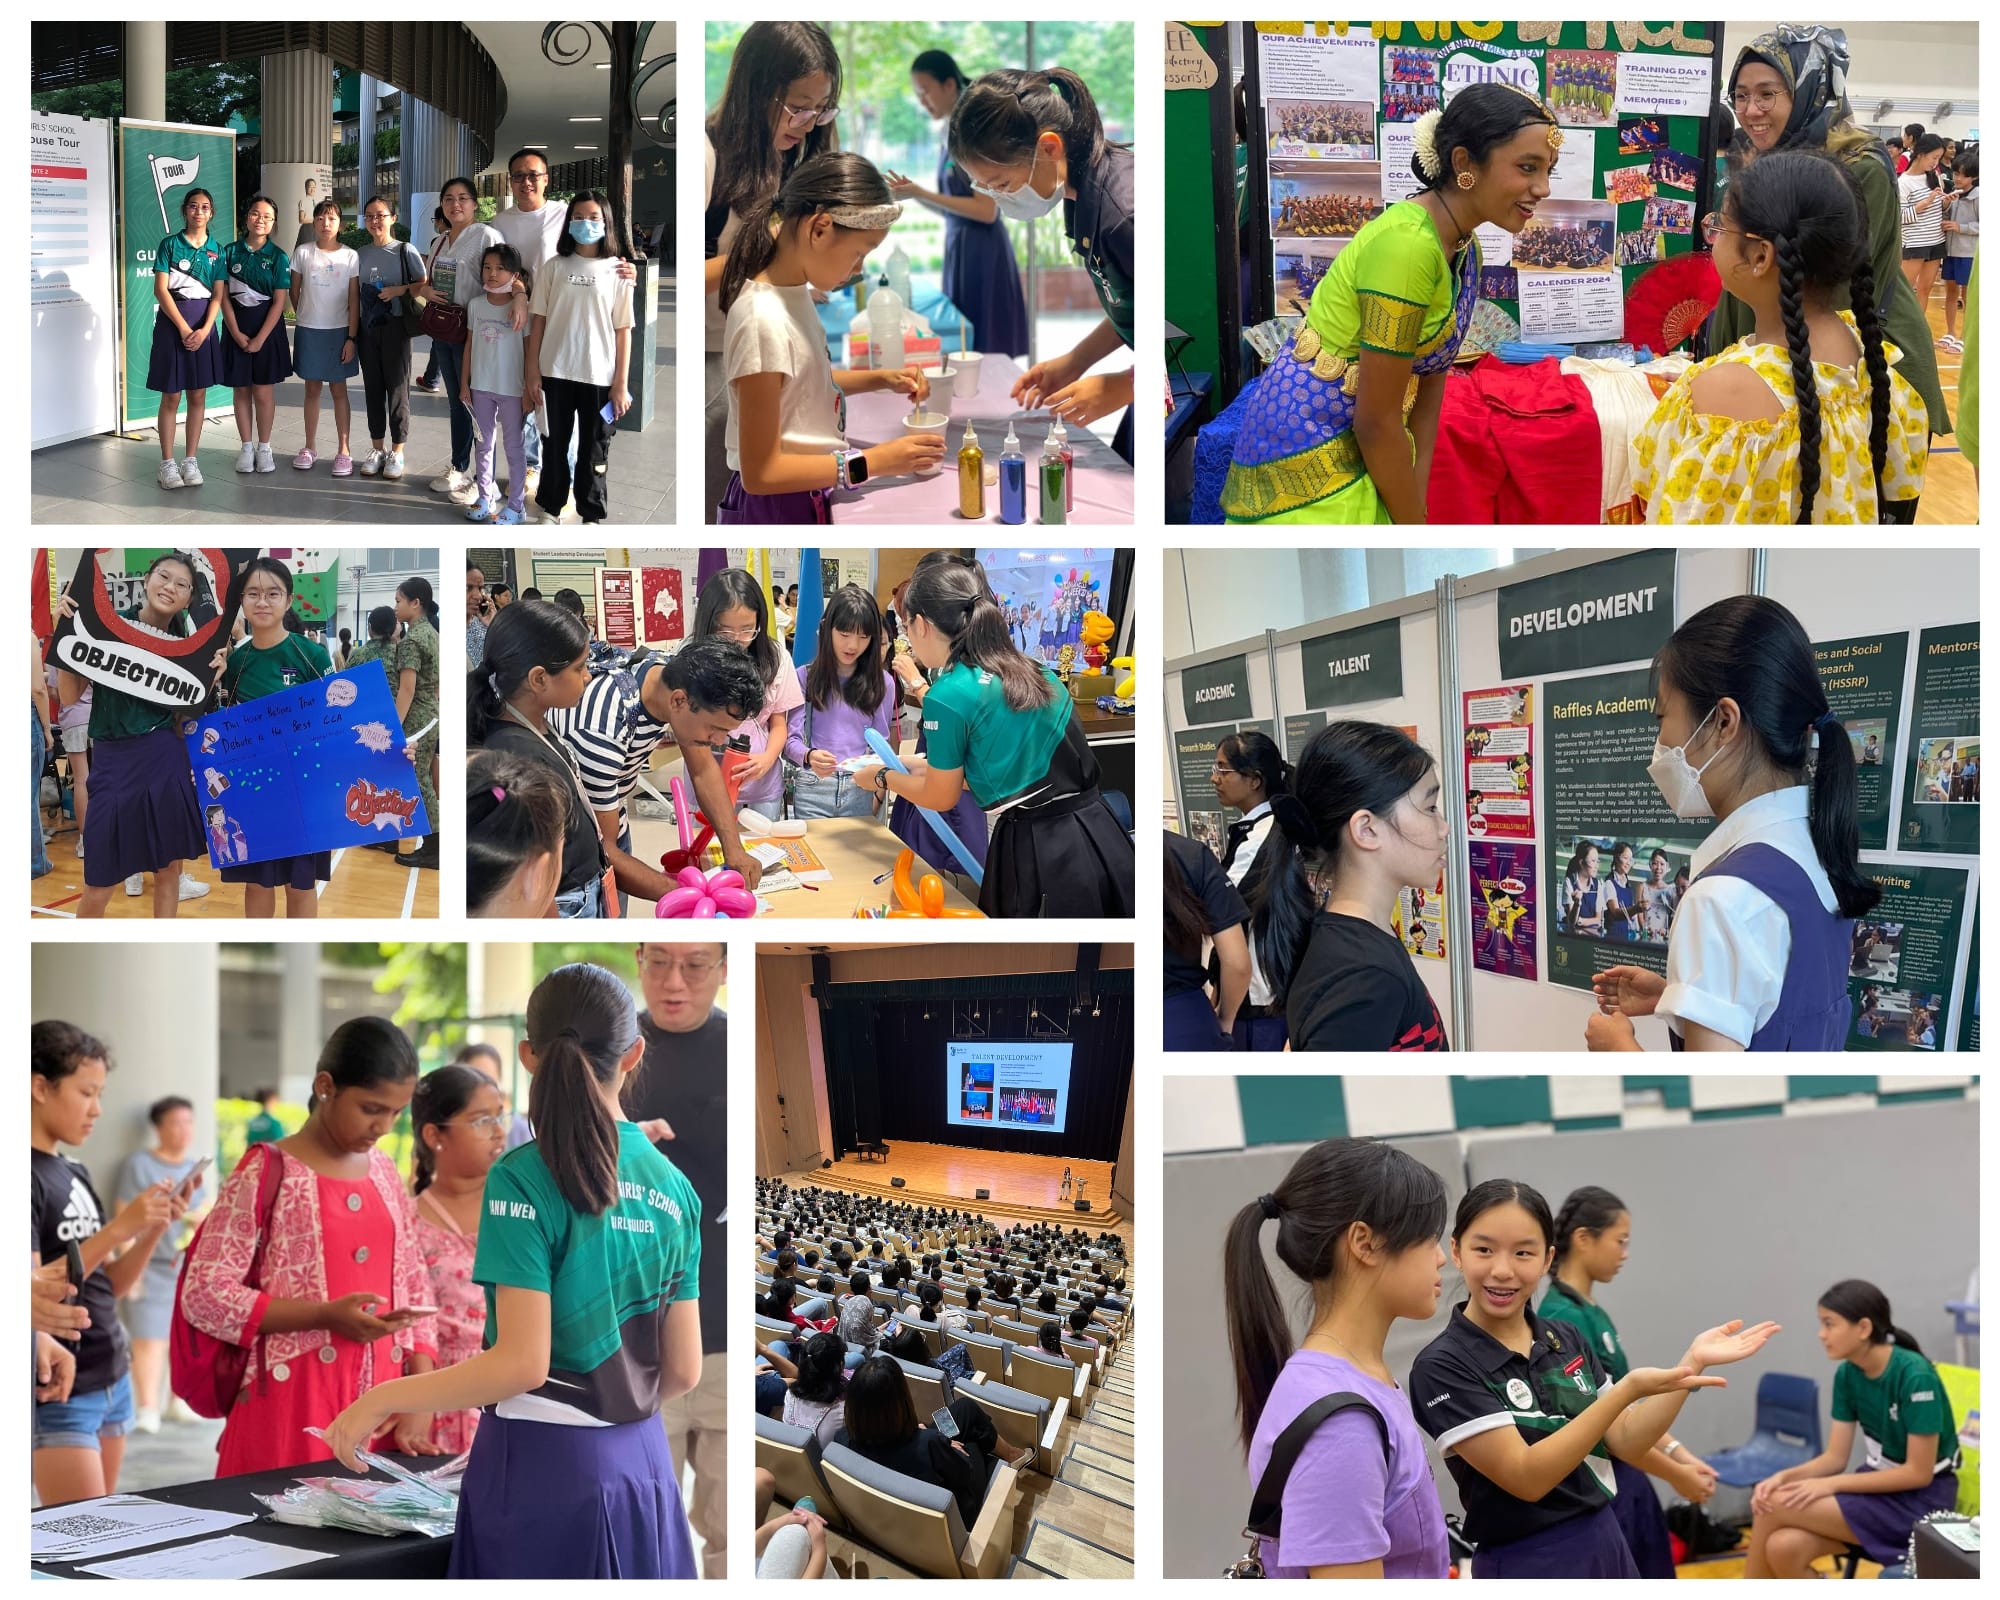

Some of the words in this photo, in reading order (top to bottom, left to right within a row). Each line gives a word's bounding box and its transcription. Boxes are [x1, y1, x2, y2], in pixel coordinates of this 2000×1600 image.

[1167, 31, 1192, 51] EE
[1262, 35, 1286, 43] OUR
[1287, 36, 1376, 48] ACHIEVEMENTS
[1438, 44, 1453, 58] WE
[1454, 39, 1486, 50] NEVER
[1486, 44, 1508, 56] MISS
[1511, 49, 1517, 57] A
[1520, 49, 1543, 58] BEAT
[1446, 63, 1535, 87] ETHNIC
[1625, 65, 1676, 74] TRAINING
[1678, 68, 1707, 76] DAYS
[1624, 96, 1681, 105] MEMORIES
[31, 122, 48, 132] IRLS'
[49, 124, 76, 135] SCHOOL
[57, 137, 81, 148] Tour
[162, 164, 185, 179] TOUR
[1527, 278, 1585, 287] CALENDER
[1586, 276, 1611, 284] 2024
[1510, 586, 1658, 638] DEVELOPMENT
[1814, 650, 1828, 660] ies
[1830, 646, 1850, 659] and
[1851, 642, 1882, 656] Social
[1928, 641, 1980, 655] Mentors
[70, 640, 201, 704] OBJECTION!
[1328, 653, 1371, 678] TALENT
[1817, 662, 1854, 675] esearch
[1828, 675, 1869, 691] (HSSRP)
[1195, 683, 1236, 704] ACADEMIC
[1553, 702, 1593, 720] Raffles
[1595, 696, 1657, 715] Academy
[1648, 725, 1659, 734] help
[1179, 744, 1199, 753] Research
[1199, 741, 1217, 752] Studies
[1601, 738, 1620, 746] learning
[1635, 744, 1655, 752] knowle
[1632, 817, 1657, 825] participate
[1659, 817, 1676, 825] readily
[1871, 875, 1911, 889] Writing
[1418, 888, 1425, 907] 3
[1438, 937, 1446, 958] 5
[510, 1201, 536, 1221] WEN
[648, 1188, 683, 1226] SCHOOL
